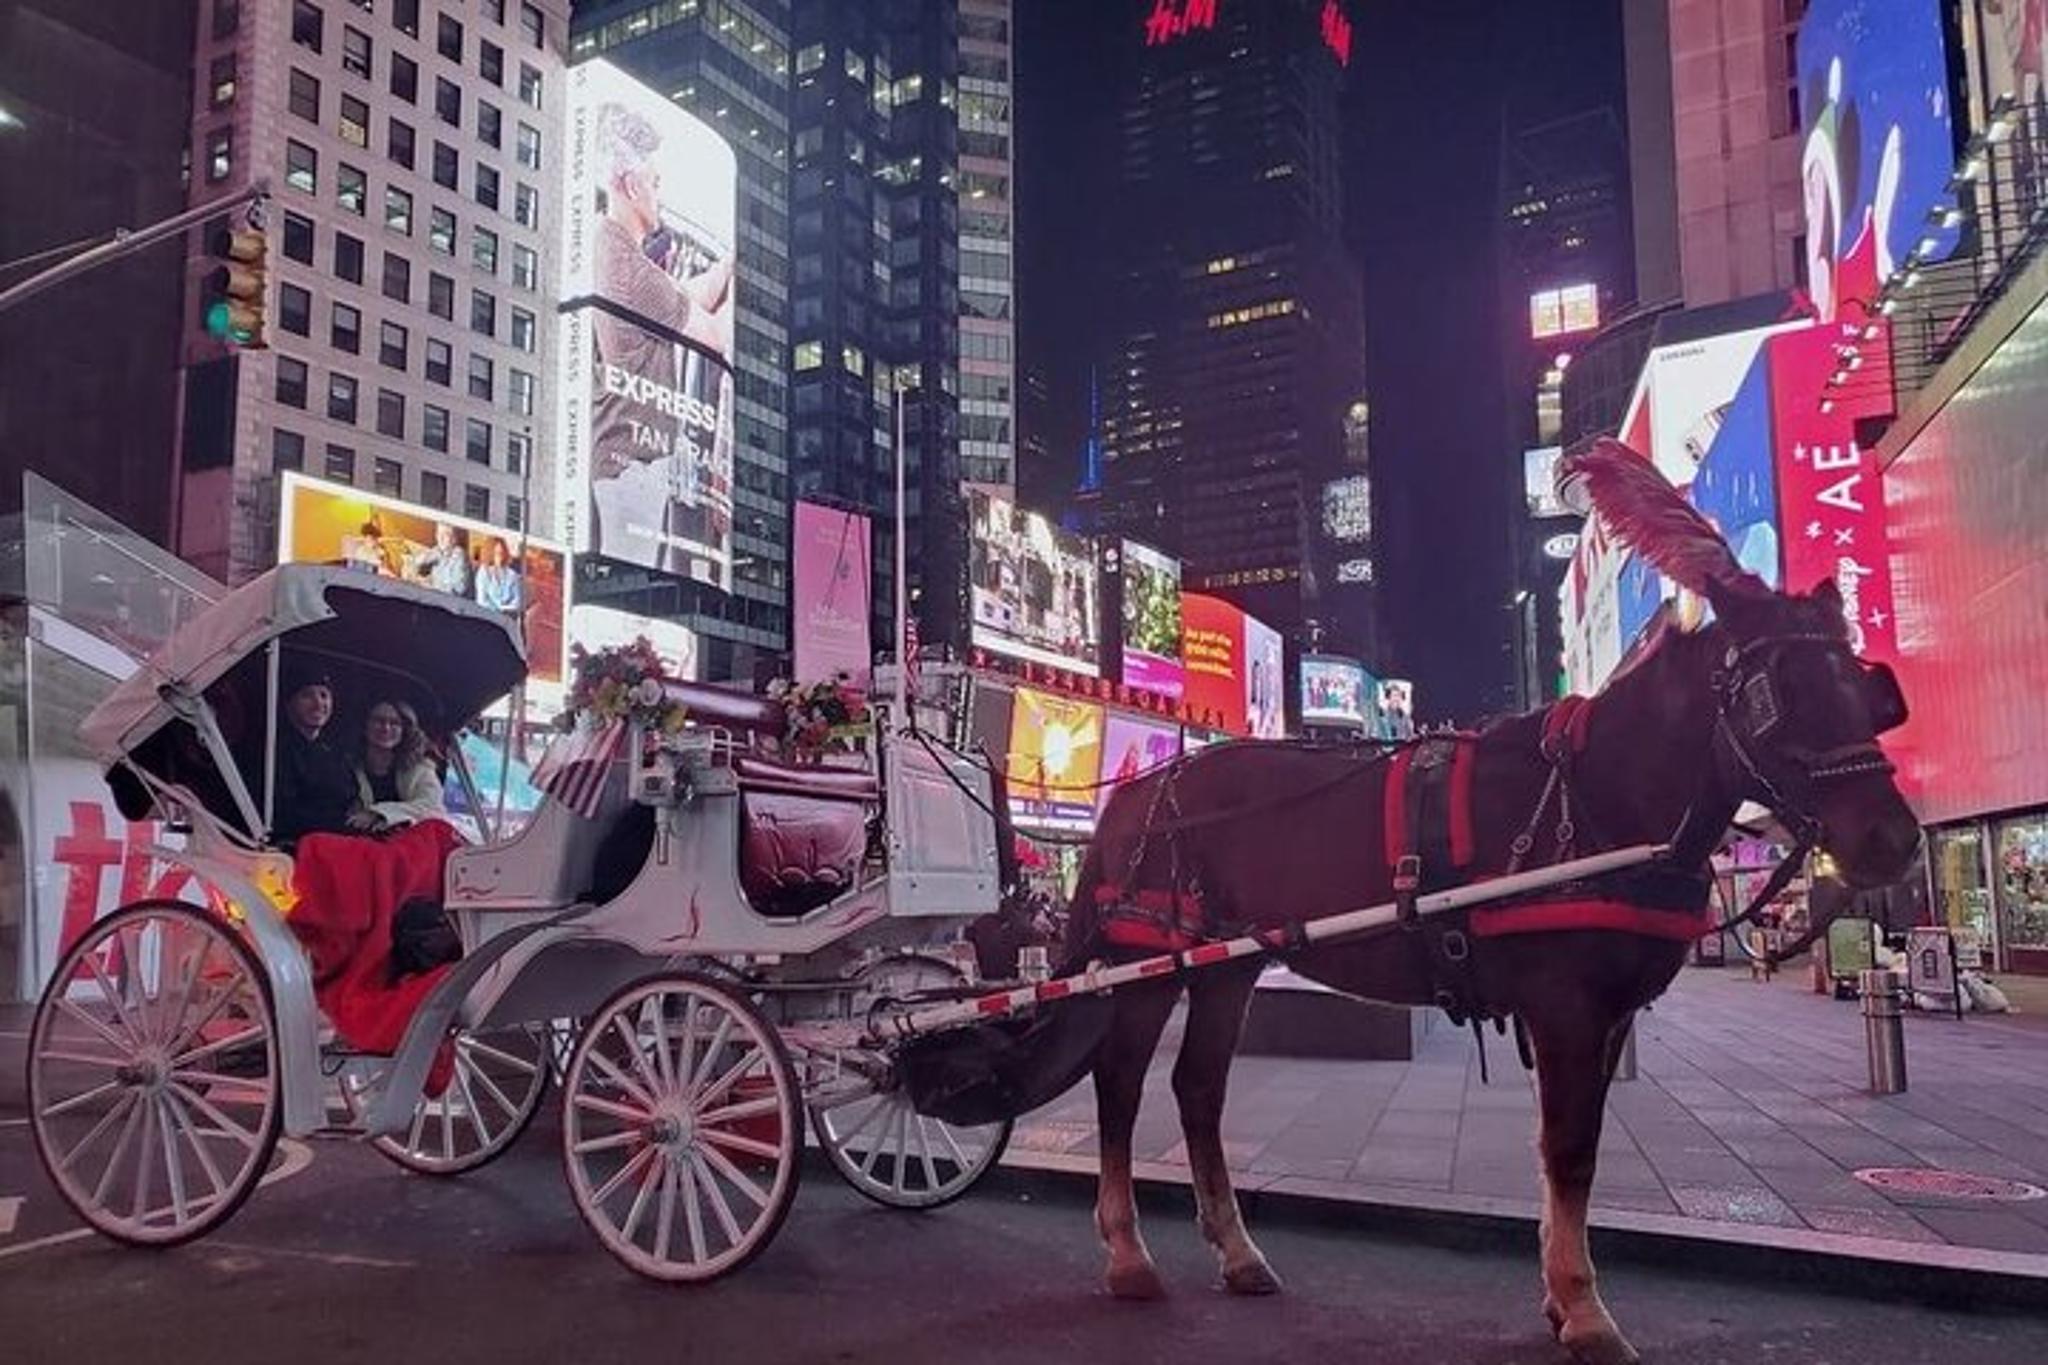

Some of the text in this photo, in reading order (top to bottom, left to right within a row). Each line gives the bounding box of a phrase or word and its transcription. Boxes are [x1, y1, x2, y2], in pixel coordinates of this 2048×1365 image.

[605, 364, 716, 433] EXPRESS
[564, 398, 578, 480] EXPRESS
[627, 420, 670, 454] TAN
[1812, 440, 1865, 512] AE
